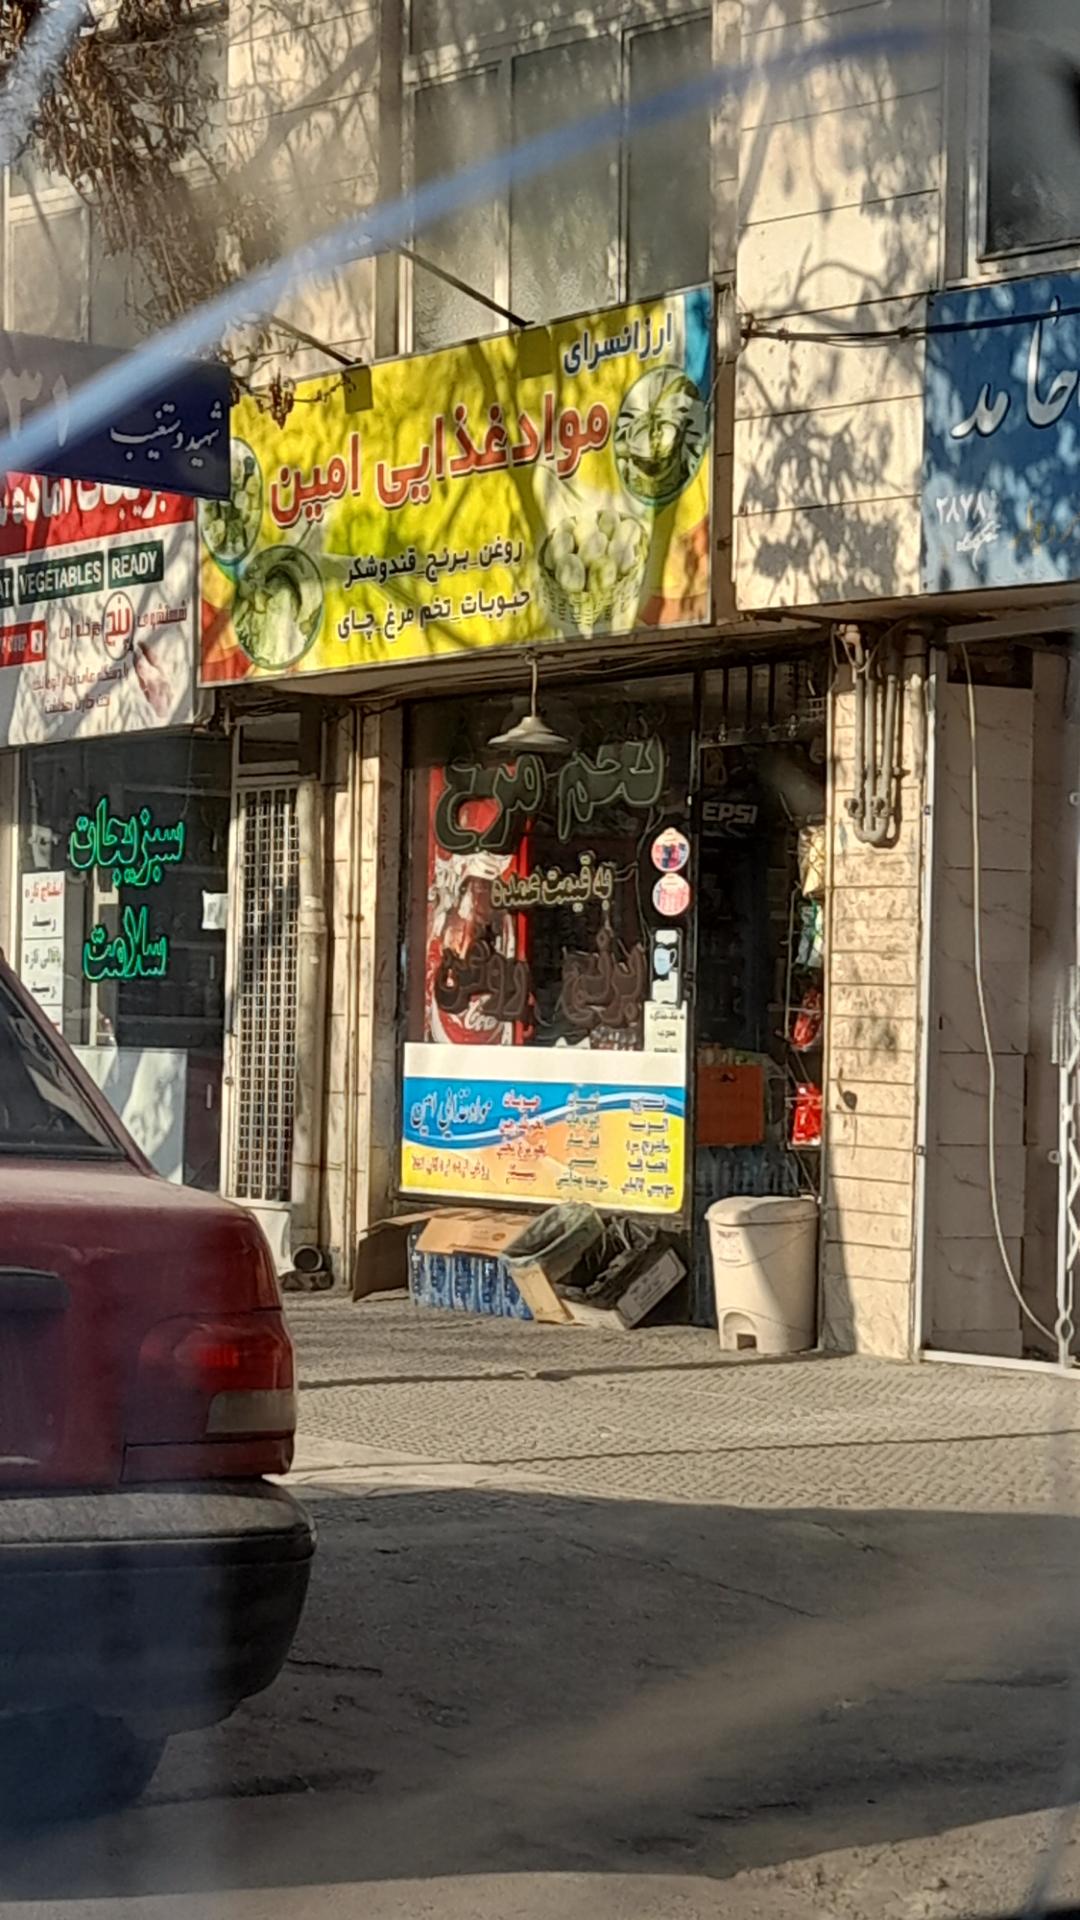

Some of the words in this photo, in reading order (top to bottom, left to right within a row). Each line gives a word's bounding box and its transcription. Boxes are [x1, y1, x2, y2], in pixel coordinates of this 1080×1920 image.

[184, 401, 222, 467] شهید
[270, 432, 361, 527] امین
[19, 560, 102, 595] VEGETABLES
[111, 551, 158, 580] READY
[385, 603, 414, 639] مرغ
[420, 598, 451, 628] تخم
[461, 590, 530, 619] حبوبات
[338, 609, 375, 641] چای
[702, 801, 758, 825] EPSI
[542, 854, 592, 913] قیمت
[83, 905, 167, 981] سلامت
